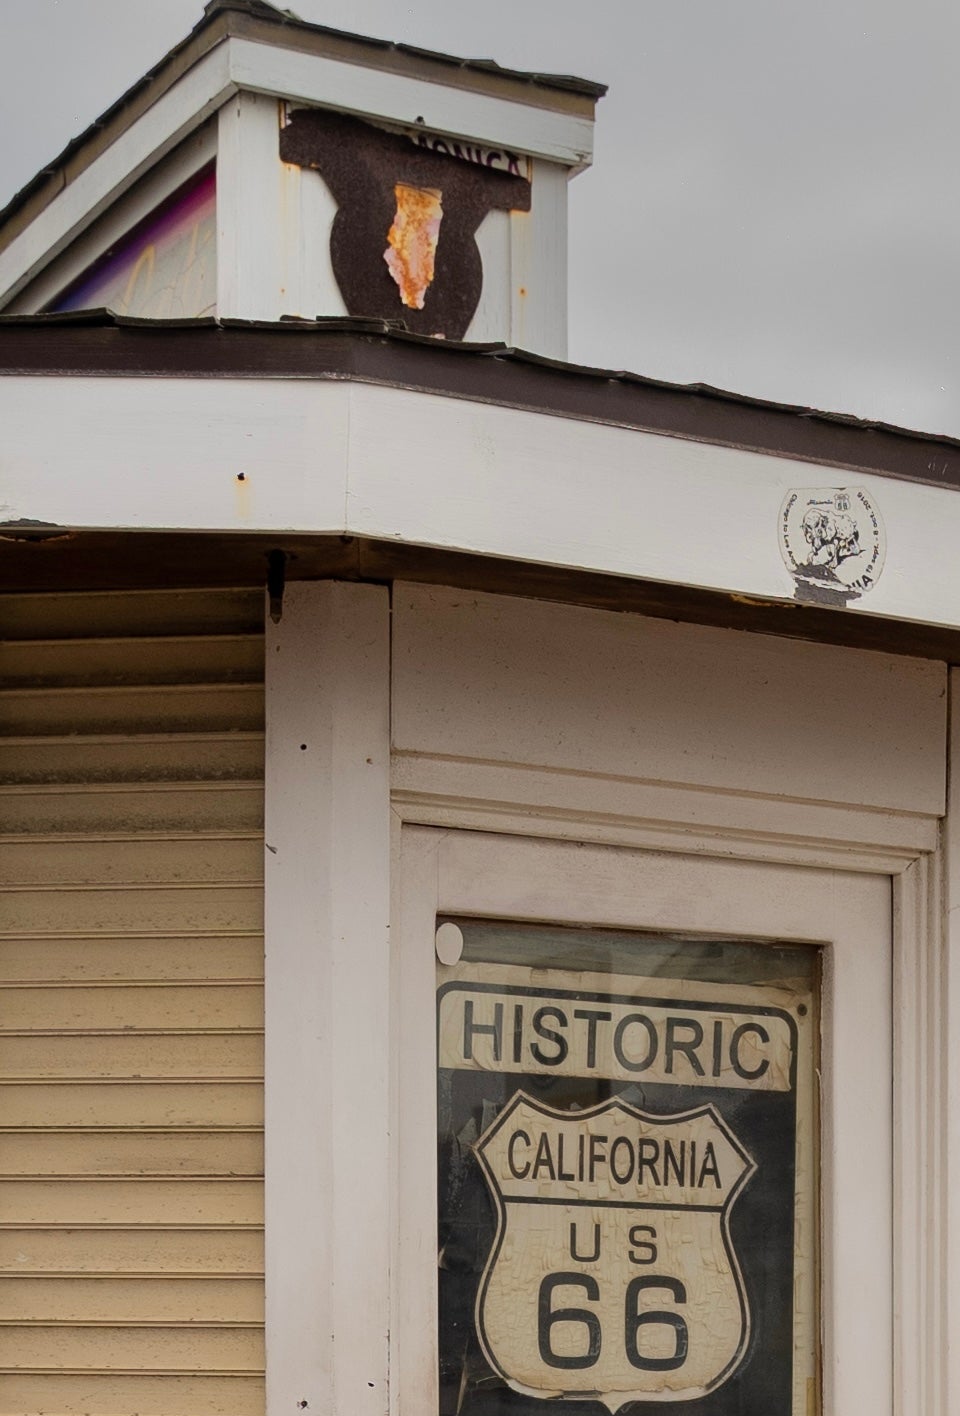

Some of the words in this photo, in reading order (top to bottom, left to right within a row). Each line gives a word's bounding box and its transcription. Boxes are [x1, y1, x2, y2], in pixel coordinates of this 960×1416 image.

[463, 1000, 770, 1080] HISTORIC
[508, 1130, 721, 1189] CALIFORNIA
[538, 1271, 688, 1371] 66
